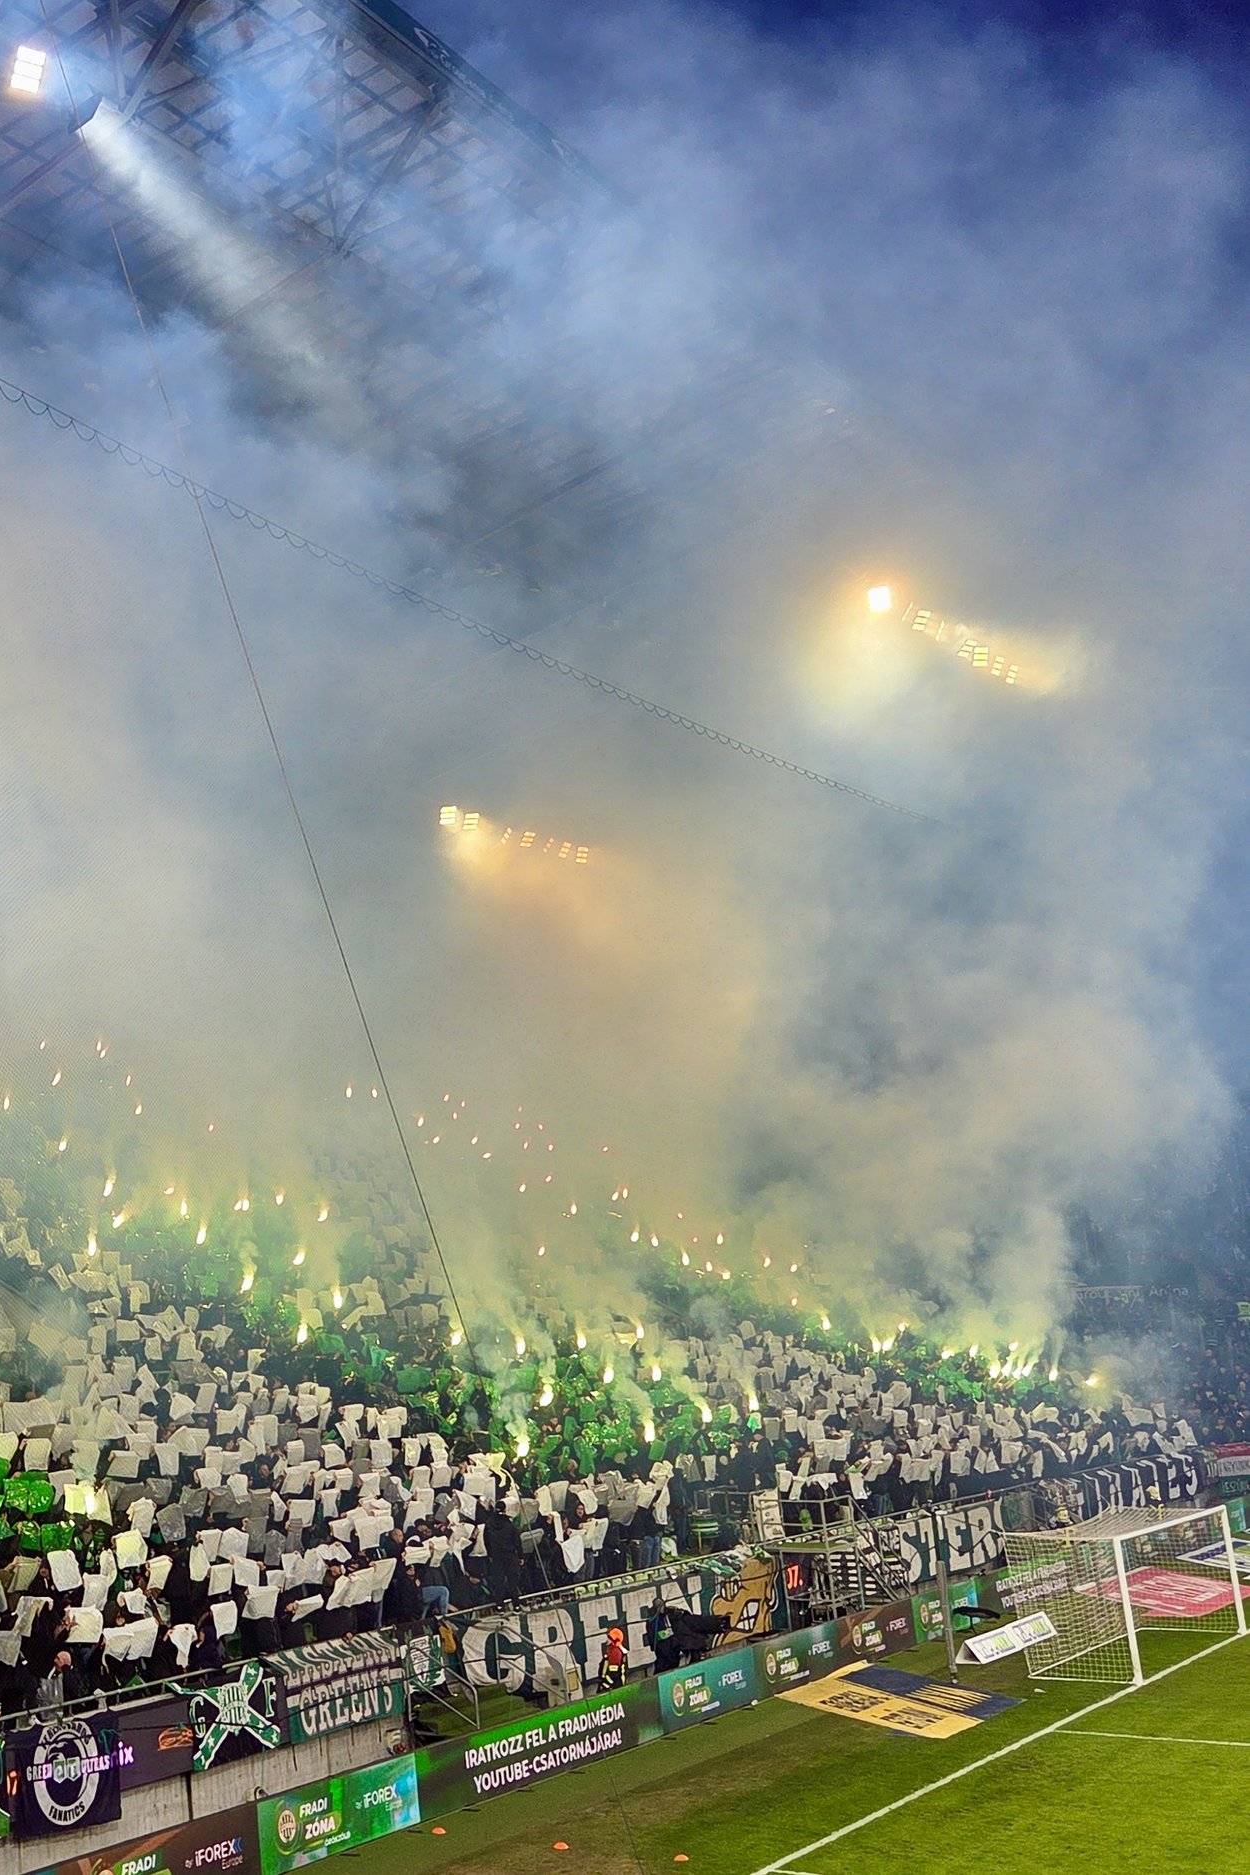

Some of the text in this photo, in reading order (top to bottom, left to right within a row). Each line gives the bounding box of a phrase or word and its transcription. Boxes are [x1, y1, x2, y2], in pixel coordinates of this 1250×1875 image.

[299, 1667, 393, 1736] GREENS
[464, 1702, 625, 1769] IRATKOZZ FEL A FRADIMÉDIA
[473, 1728, 622, 1794] YOUTUBE-CSATORNÁJÁRA!
[49, 1801, 86, 1822] FANATICS
[299, 1797, 328, 1818] FRADI
[305, 1816, 336, 1840] ZÓNA
[121, 1854, 156, 1875] FRADI
[195, 1839, 236, 1867] iFOREX
[222, 1855, 244, 1870] Europe
